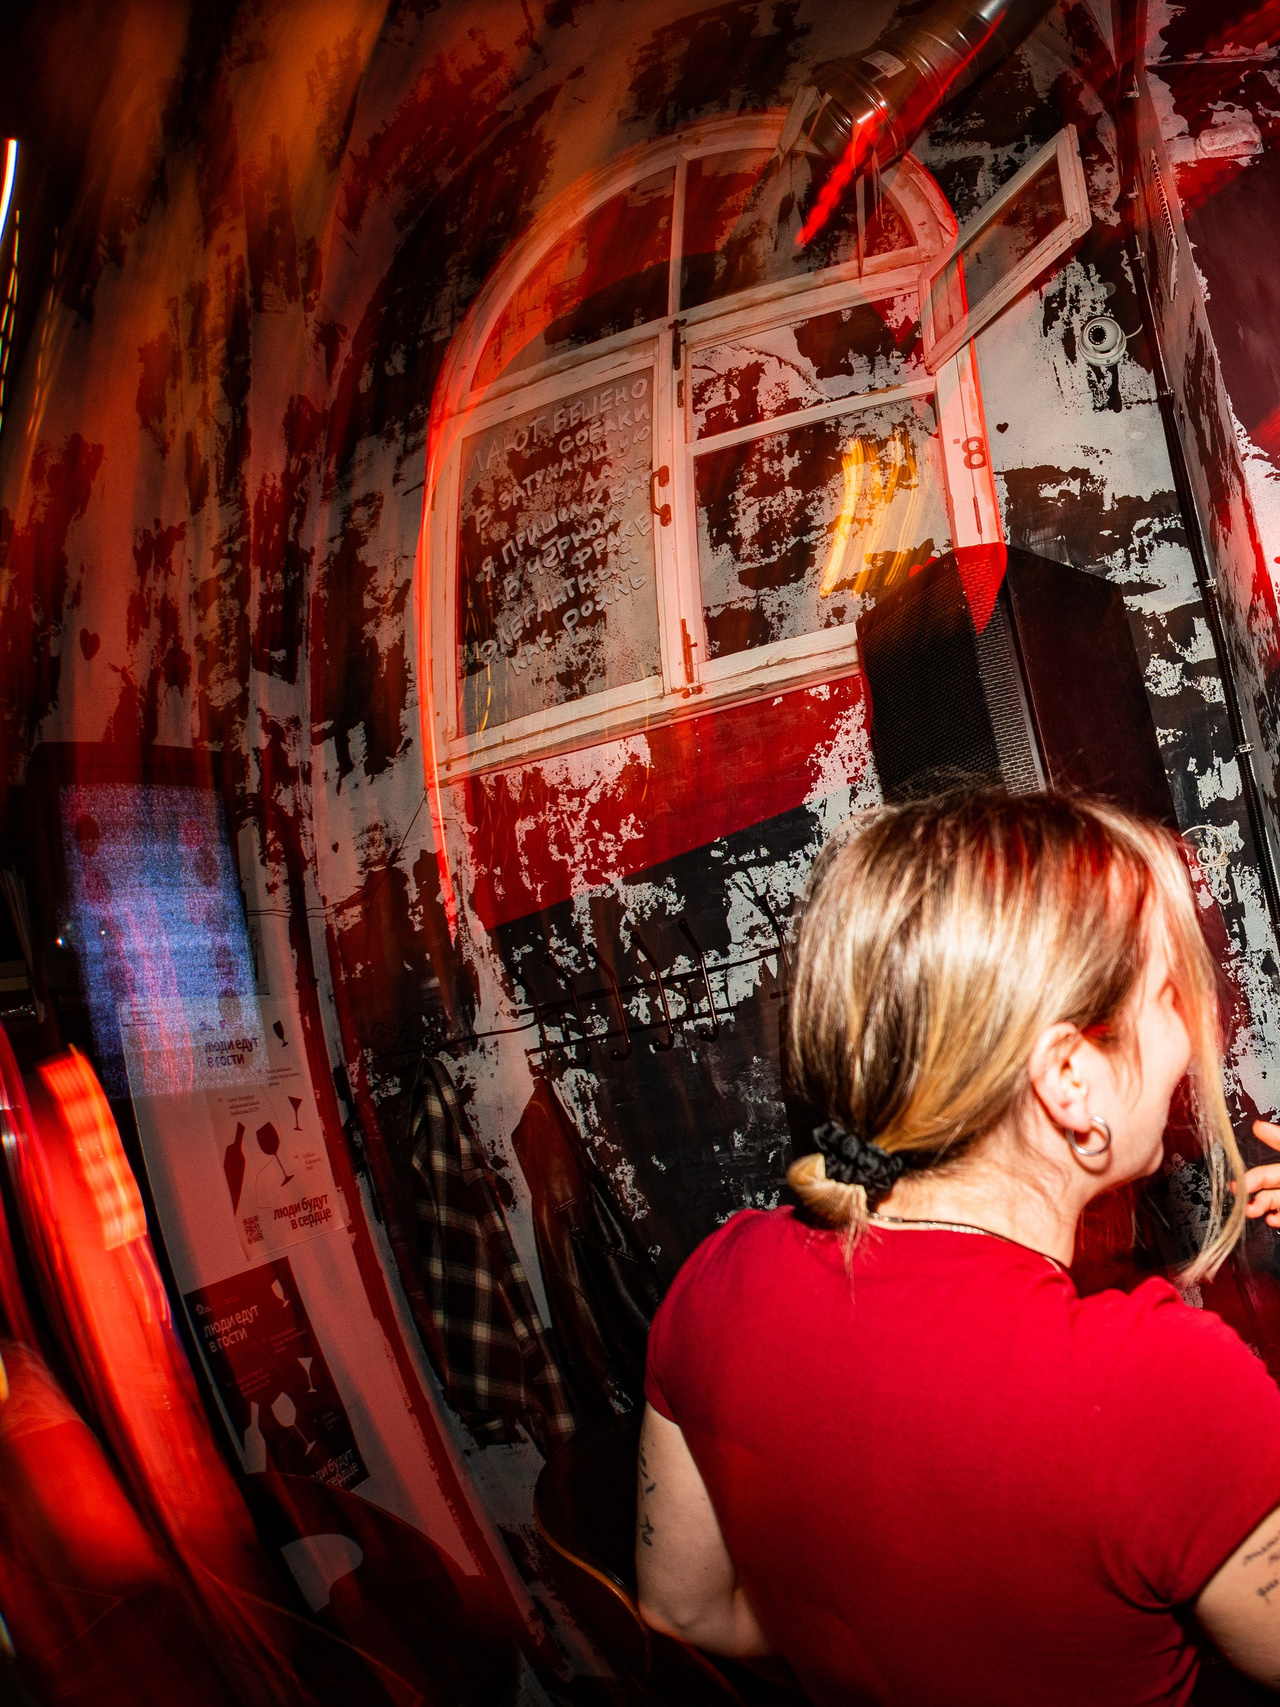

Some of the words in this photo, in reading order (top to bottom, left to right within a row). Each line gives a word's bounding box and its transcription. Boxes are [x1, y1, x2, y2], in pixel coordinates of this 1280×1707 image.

[553, 377, 648, 434] БЕШЕНО
[558, 403, 651, 454] СОБАКИ
[474, 504, 492, 533] В
[570, 511, 653, 570] ФРАКЕ
[481, 555, 497, 583] Я
[503, 575, 521, 601] В
[511, 630, 553, 676] КАК
[204, 1039, 235, 1054] люди
[235, 1037, 259, 1052] едут
[207, 1056, 214, 1068] в
[215, 1054, 245, 1067] гости
[273, 1203, 302, 1220] люди
[301, 1194, 329, 1213] будут
[291, 1219, 298, 1230] в
[298, 1208, 332, 1228] сердце
[203, 1316, 236, 1338] люди
[235, 1305, 259, 1325] едут
[208, 1341, 217, 1353] в
[217, 1328, 248, 1349] гости
[327, 1448, 354, 1473] будут
